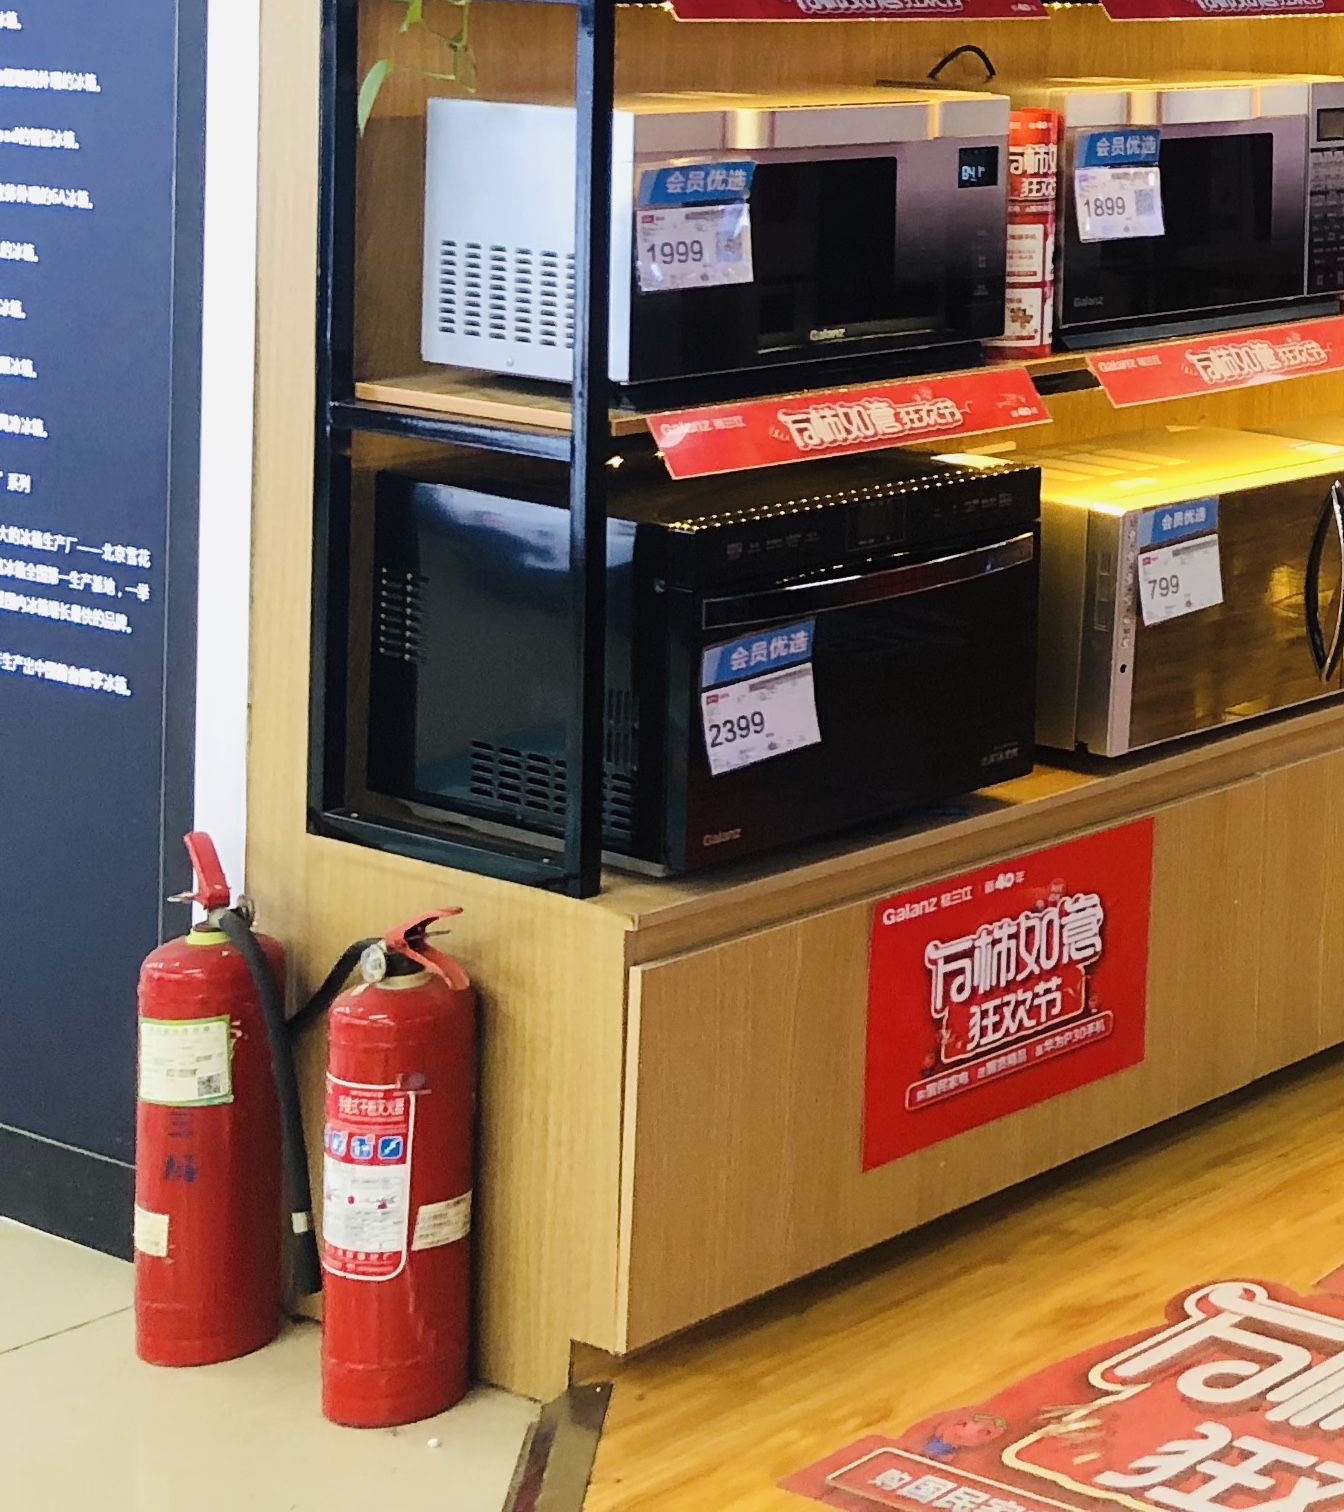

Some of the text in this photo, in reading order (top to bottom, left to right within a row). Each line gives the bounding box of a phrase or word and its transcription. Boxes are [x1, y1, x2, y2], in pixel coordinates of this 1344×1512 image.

[1096, 135, 1157, 157] 会员优选
[665, 169, 747, 194] 会员优选
[1083, 195, 1126, 218] 1899
[647, 239, 704, 265] 1999
[899, 397, 963, 431] 狂欢节
[1160, 507, 1206, 533] 会员优选
[1146, 573, 1180, 601] 799
[730, 630, 808, 671] 会员优选
[708, 709, 766, 749] 2399
[882, 896, 938, 926] Galanz
[966, 976, 1064, 1052] 狂欢节
